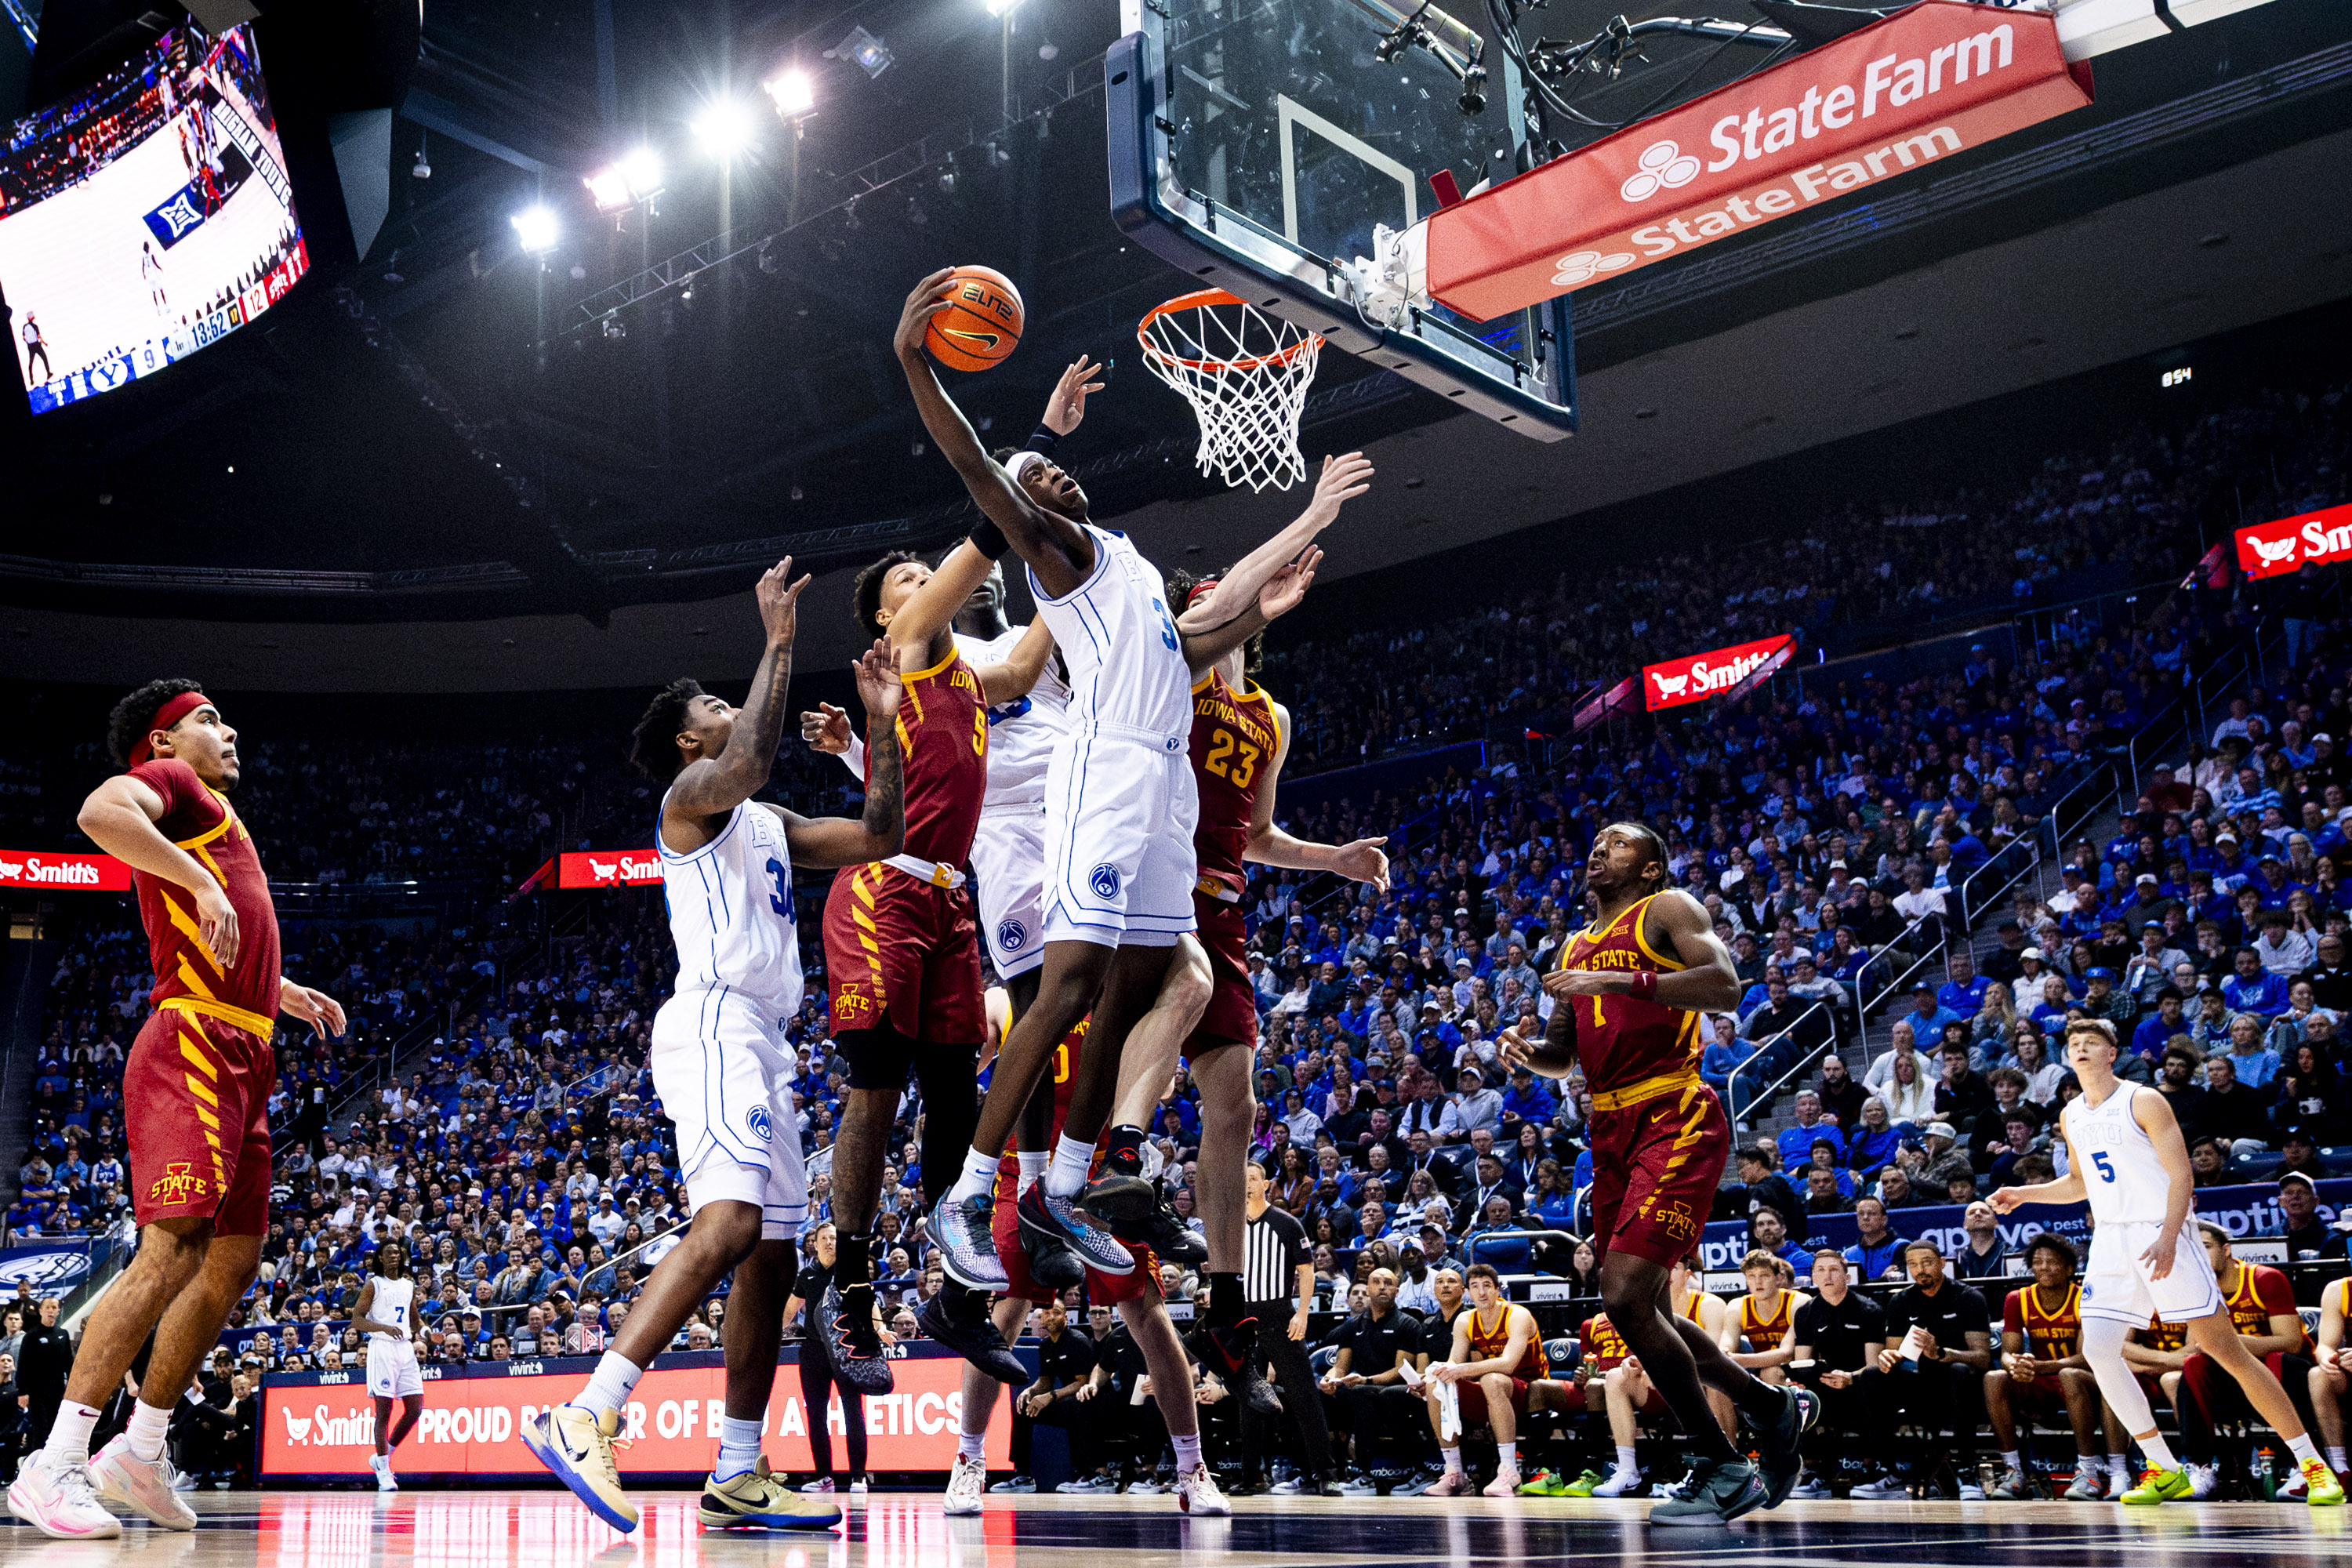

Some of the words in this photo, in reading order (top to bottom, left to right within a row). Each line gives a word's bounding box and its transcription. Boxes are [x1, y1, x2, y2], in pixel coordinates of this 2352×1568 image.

[212, 98, 260, 158] BRIGHAM
[255, 148, 292, 207] YOUNG
[249, 289, 263, 314] 12
[962, 286, 1013, 321] ELITE
[191, 312, 227, 347] 13:52
[144, 349, 155, 368] 9
[1152, 597, 1178, 652] 3
[973, 706, 985, 756] 5
[1194, 699, 1236, 724] IOWA
[1239, 714, 1275, 761] STATE
[1204, 728, 1260, 788] 23
[25, 858, 99, 884] Smith's
[1592, 949, 1641, 971] STATE
[835, 994, 869, 1013] STATE
[2090, 1151, 2115, 1183] 5
[151, 1175, 206, 1199] STATE
[1656, 1210, 1697, 1237] STATE
[2053, 1218, 2085, 1231] pest
[2195, 1196, 2336, 1236] aptie
[1920, 1221, 2045, 1258] apve
[395, 1306, 405, 1323] 7
[2047, 1342, 2070, 1360] 11
[319, 1371, 342, 1385] vivint
[420, 1367, 434, 1380] vint
[509, 1361, 535, 1376] vivint
[417, 1406, 512, 1443] PROUD
[656, 1399, 699, 1439] OF
[779, 1391, 963, 1437] AHETICS
